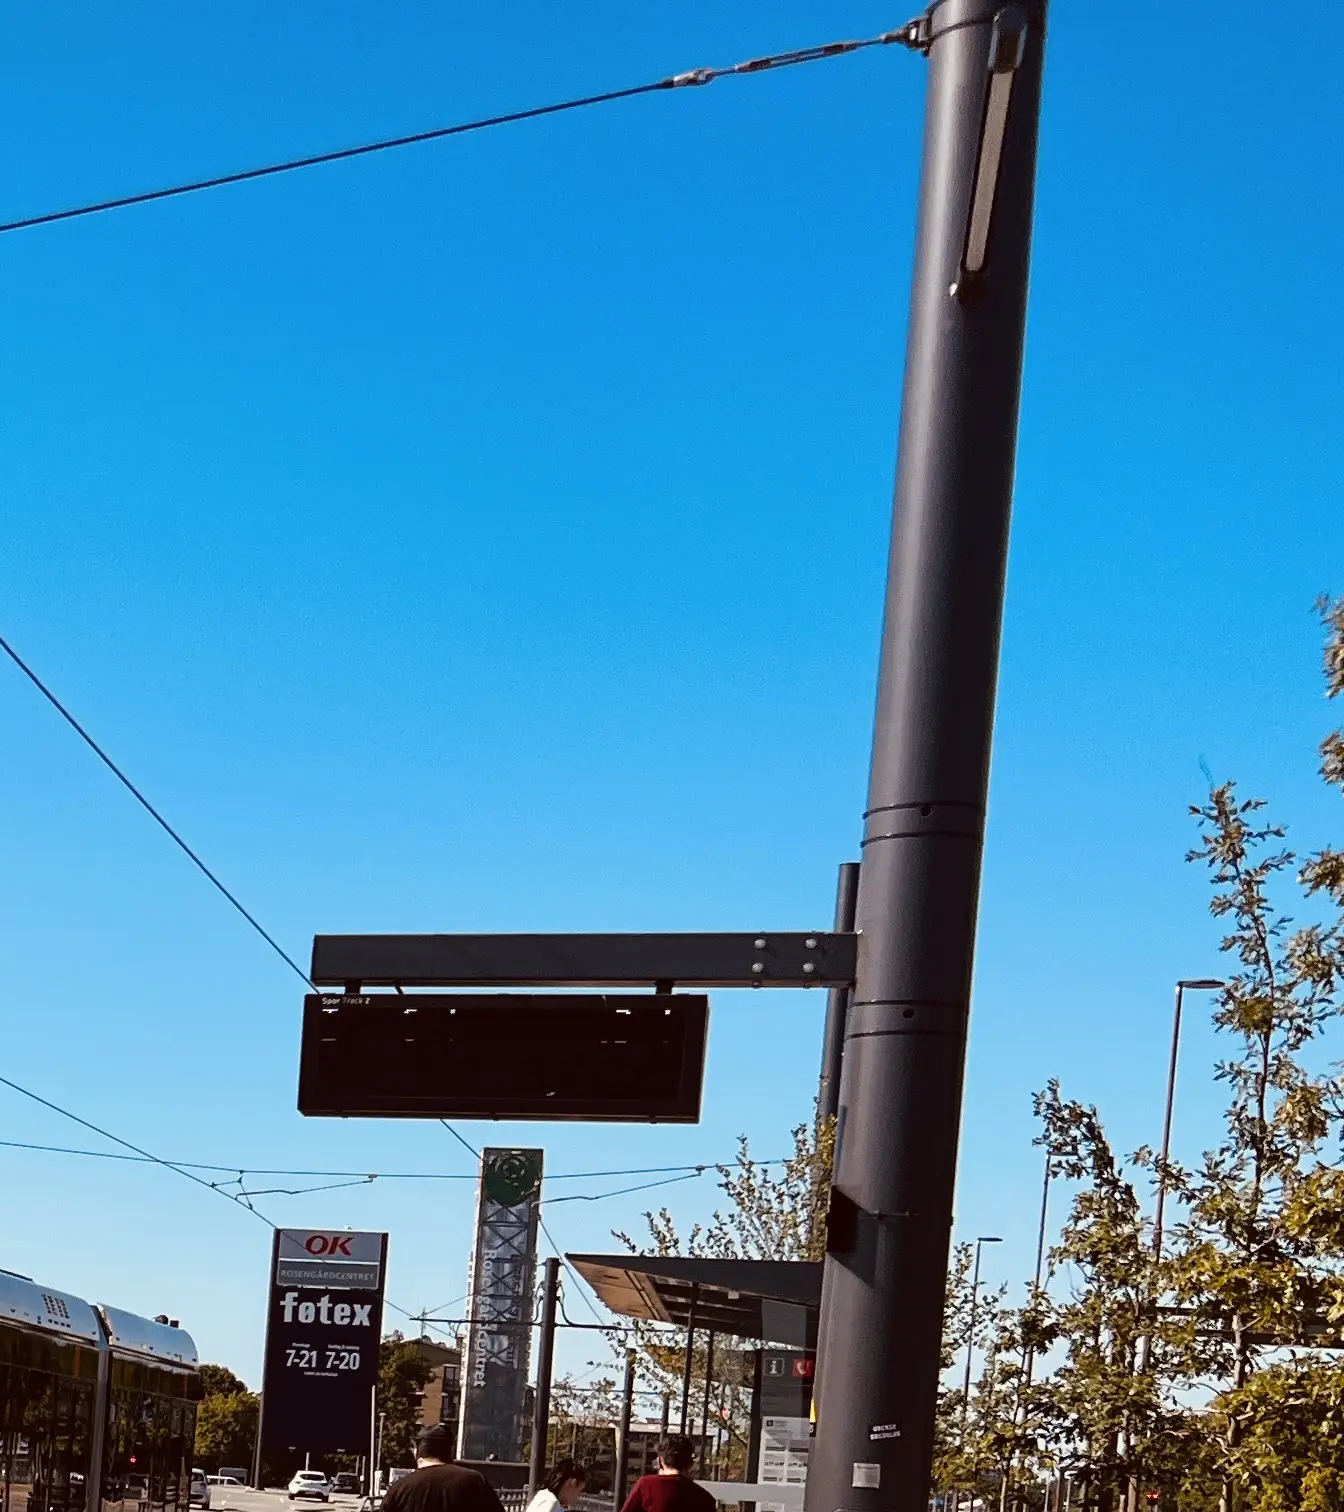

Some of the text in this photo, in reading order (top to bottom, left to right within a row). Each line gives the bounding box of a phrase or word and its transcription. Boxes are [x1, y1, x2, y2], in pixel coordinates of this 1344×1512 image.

[305, 1234, 354, 1256] OK
[280, 1268, 375, 1281] ROSENGÅRDCENTRET
[279, 1291, 372, 1327] føtex
[285, 1349, 361, 1371] 7-21 7-20
